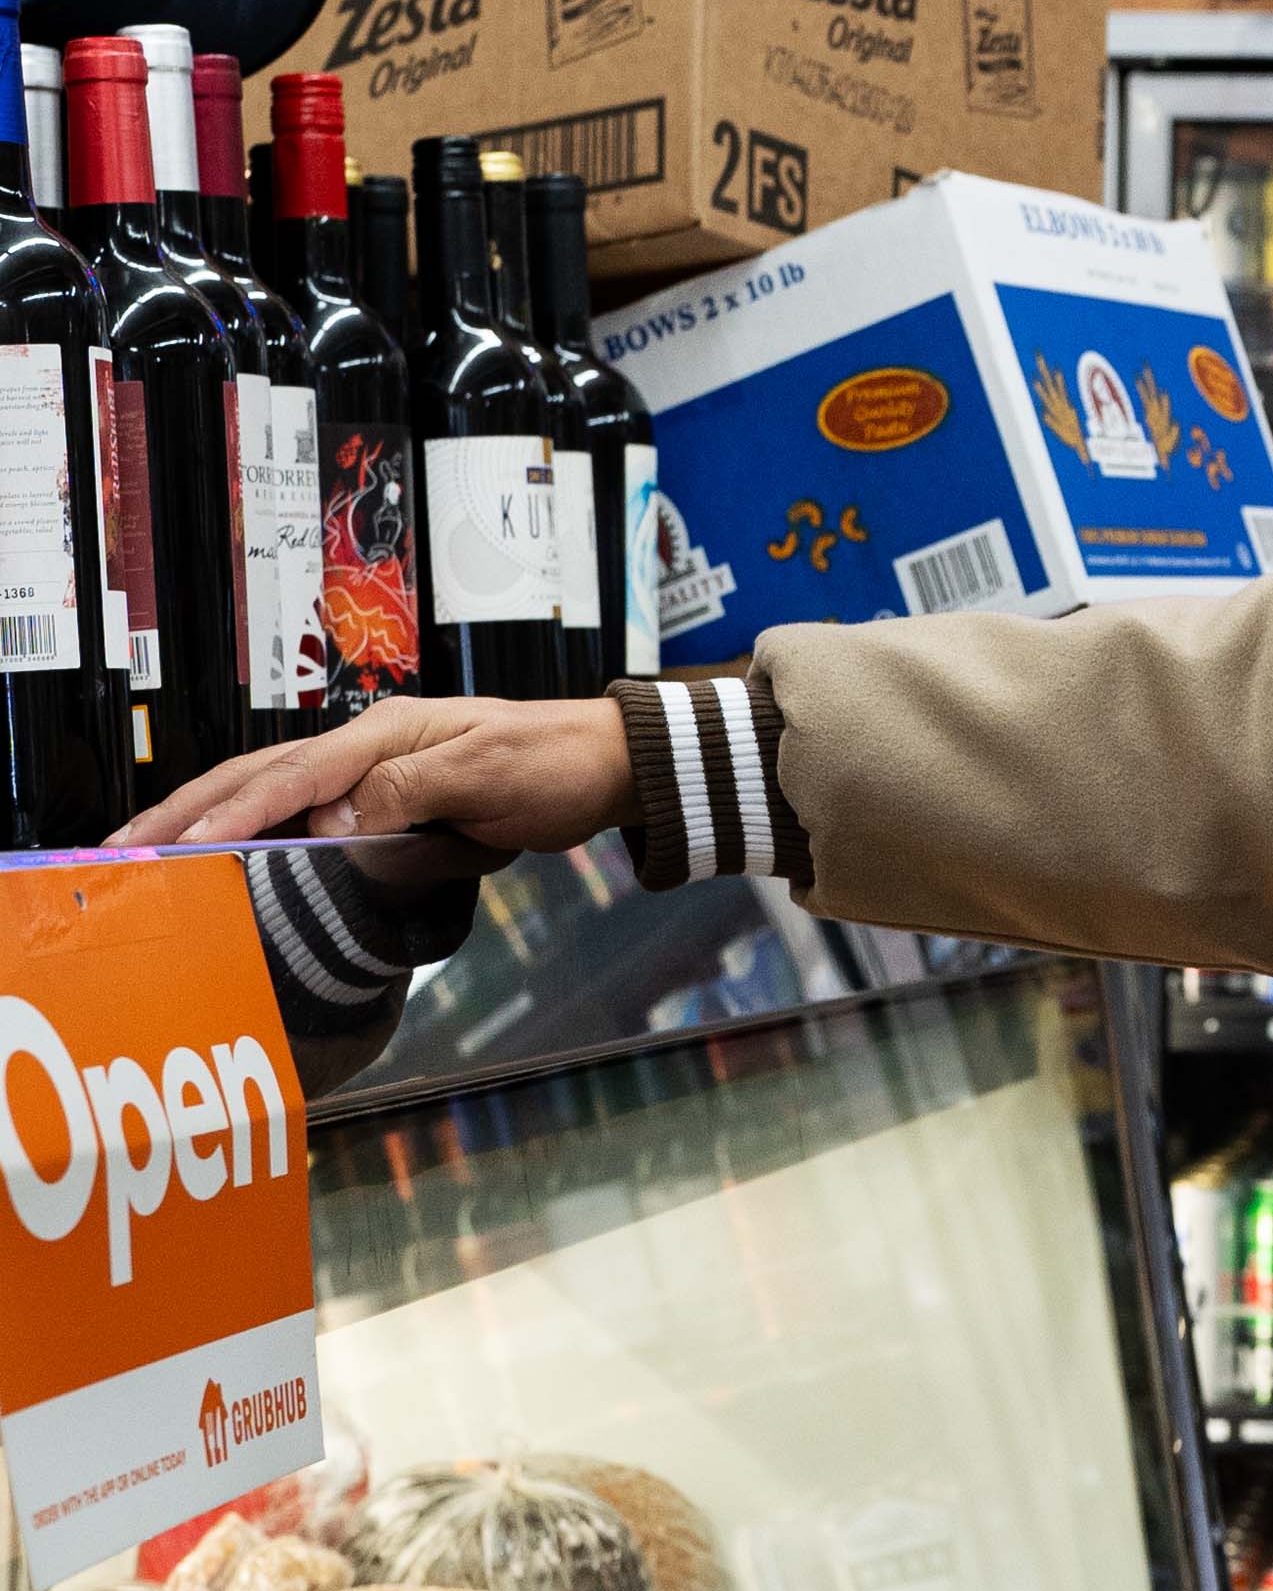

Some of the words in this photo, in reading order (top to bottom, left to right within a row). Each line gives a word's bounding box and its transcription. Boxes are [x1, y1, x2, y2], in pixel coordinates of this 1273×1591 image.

[368, 32, 479, 101] Original
[826, 14, 915, 65] Original
[603, 302, 698, 363] BOWS
[704, 296, 719, 320] 2
[725, 291, 741, 312] x
[745, 271, 776, 302] 10
[778, 262, 807, 289] lb
[277, 523, 310, 550] Red
[0, 994, 289, 1288] Open
[231, 1376, 308, 1446] GRUBHUB
[60, 1495, 82, 1519] WITH
[82, 1486, 100, 1506] THE
[100, 1478, 116, 1500] APP
[130, 1460, 161, 1488] ONLINE
[161, 1447, 187, 1476] TODAY
